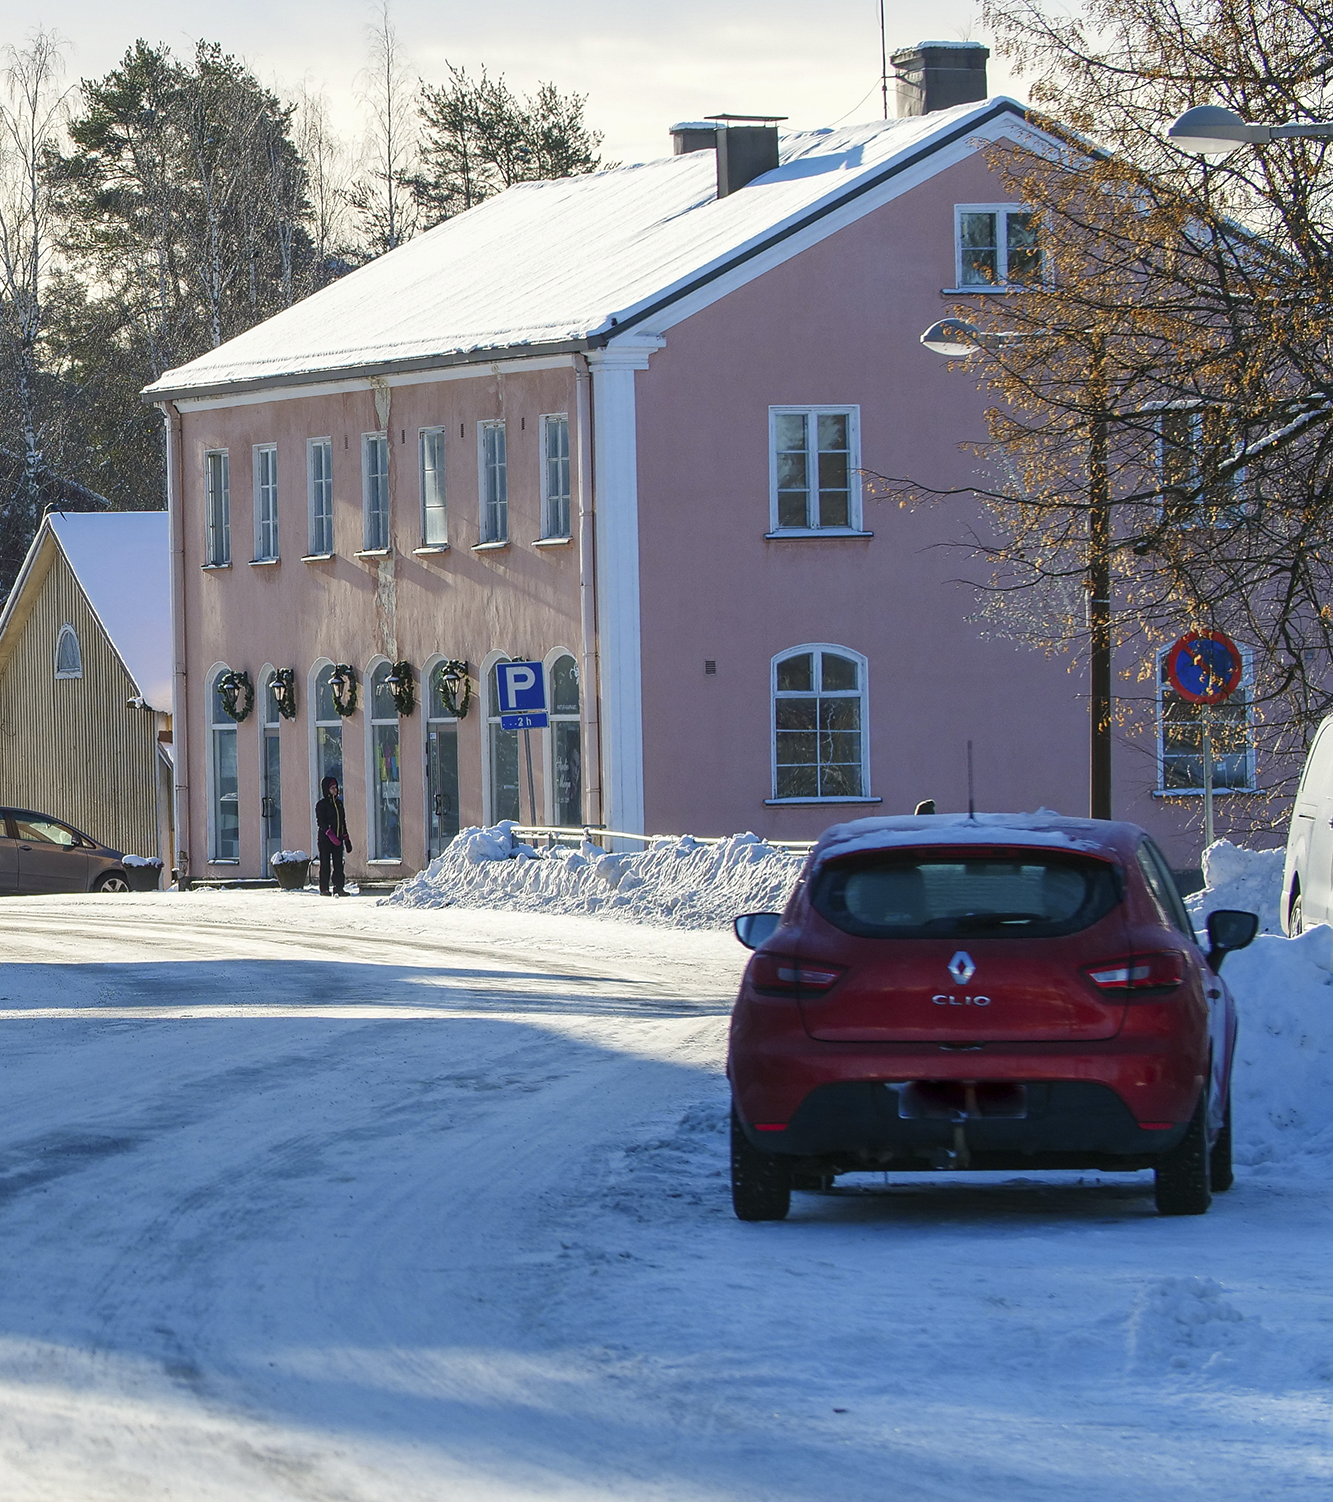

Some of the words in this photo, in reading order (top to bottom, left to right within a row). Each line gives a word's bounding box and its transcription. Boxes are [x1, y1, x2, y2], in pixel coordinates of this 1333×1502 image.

[506, 666, 536, 708] P
[517, 717, 524, 727] 2
[525, 716, 532, 726] h
[932, 995, 991, 1006] CLIO
